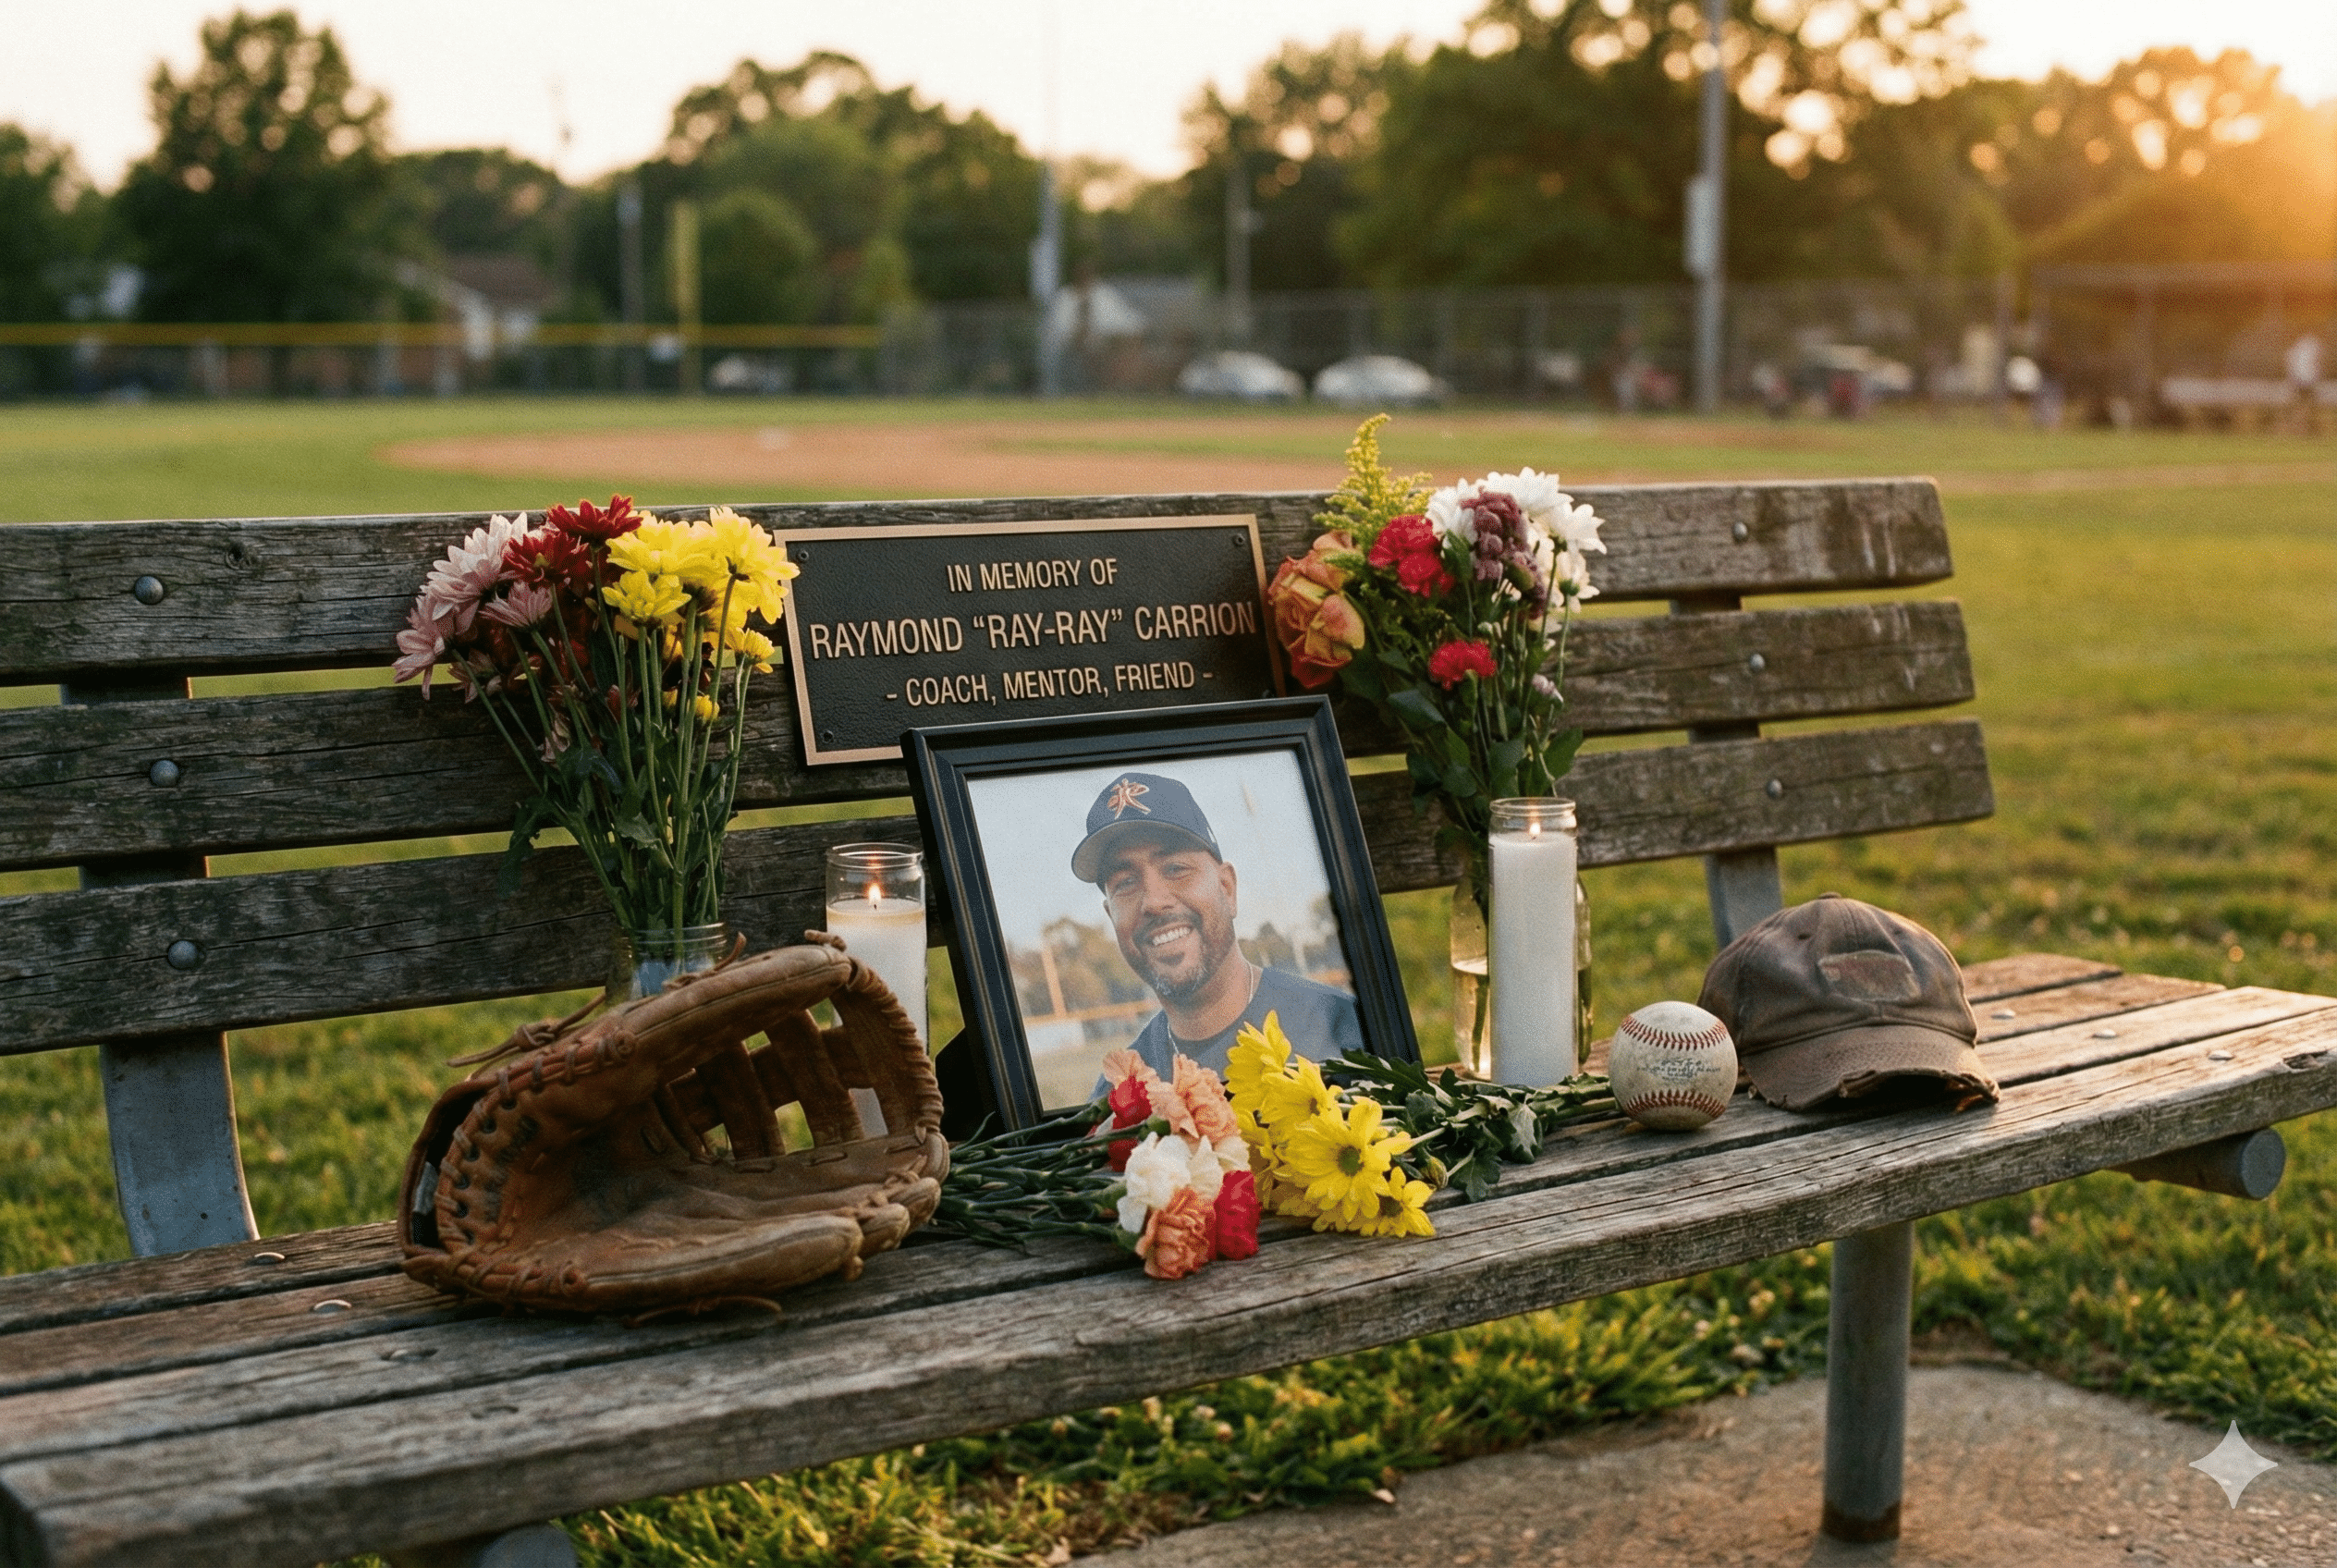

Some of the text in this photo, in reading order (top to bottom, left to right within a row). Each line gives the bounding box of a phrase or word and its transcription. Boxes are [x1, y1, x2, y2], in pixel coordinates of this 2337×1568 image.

[948, 558, 1118, 593] IN MEMORY OF
[810, 603, 1255, 658] RAYMOND “RAY-RAY” CARRION
[906, 676, 997, 706] COACH,
[1003, 668, 1108, 700] MENTOR,
[1115, 662, 1194, 692] FRIEND
